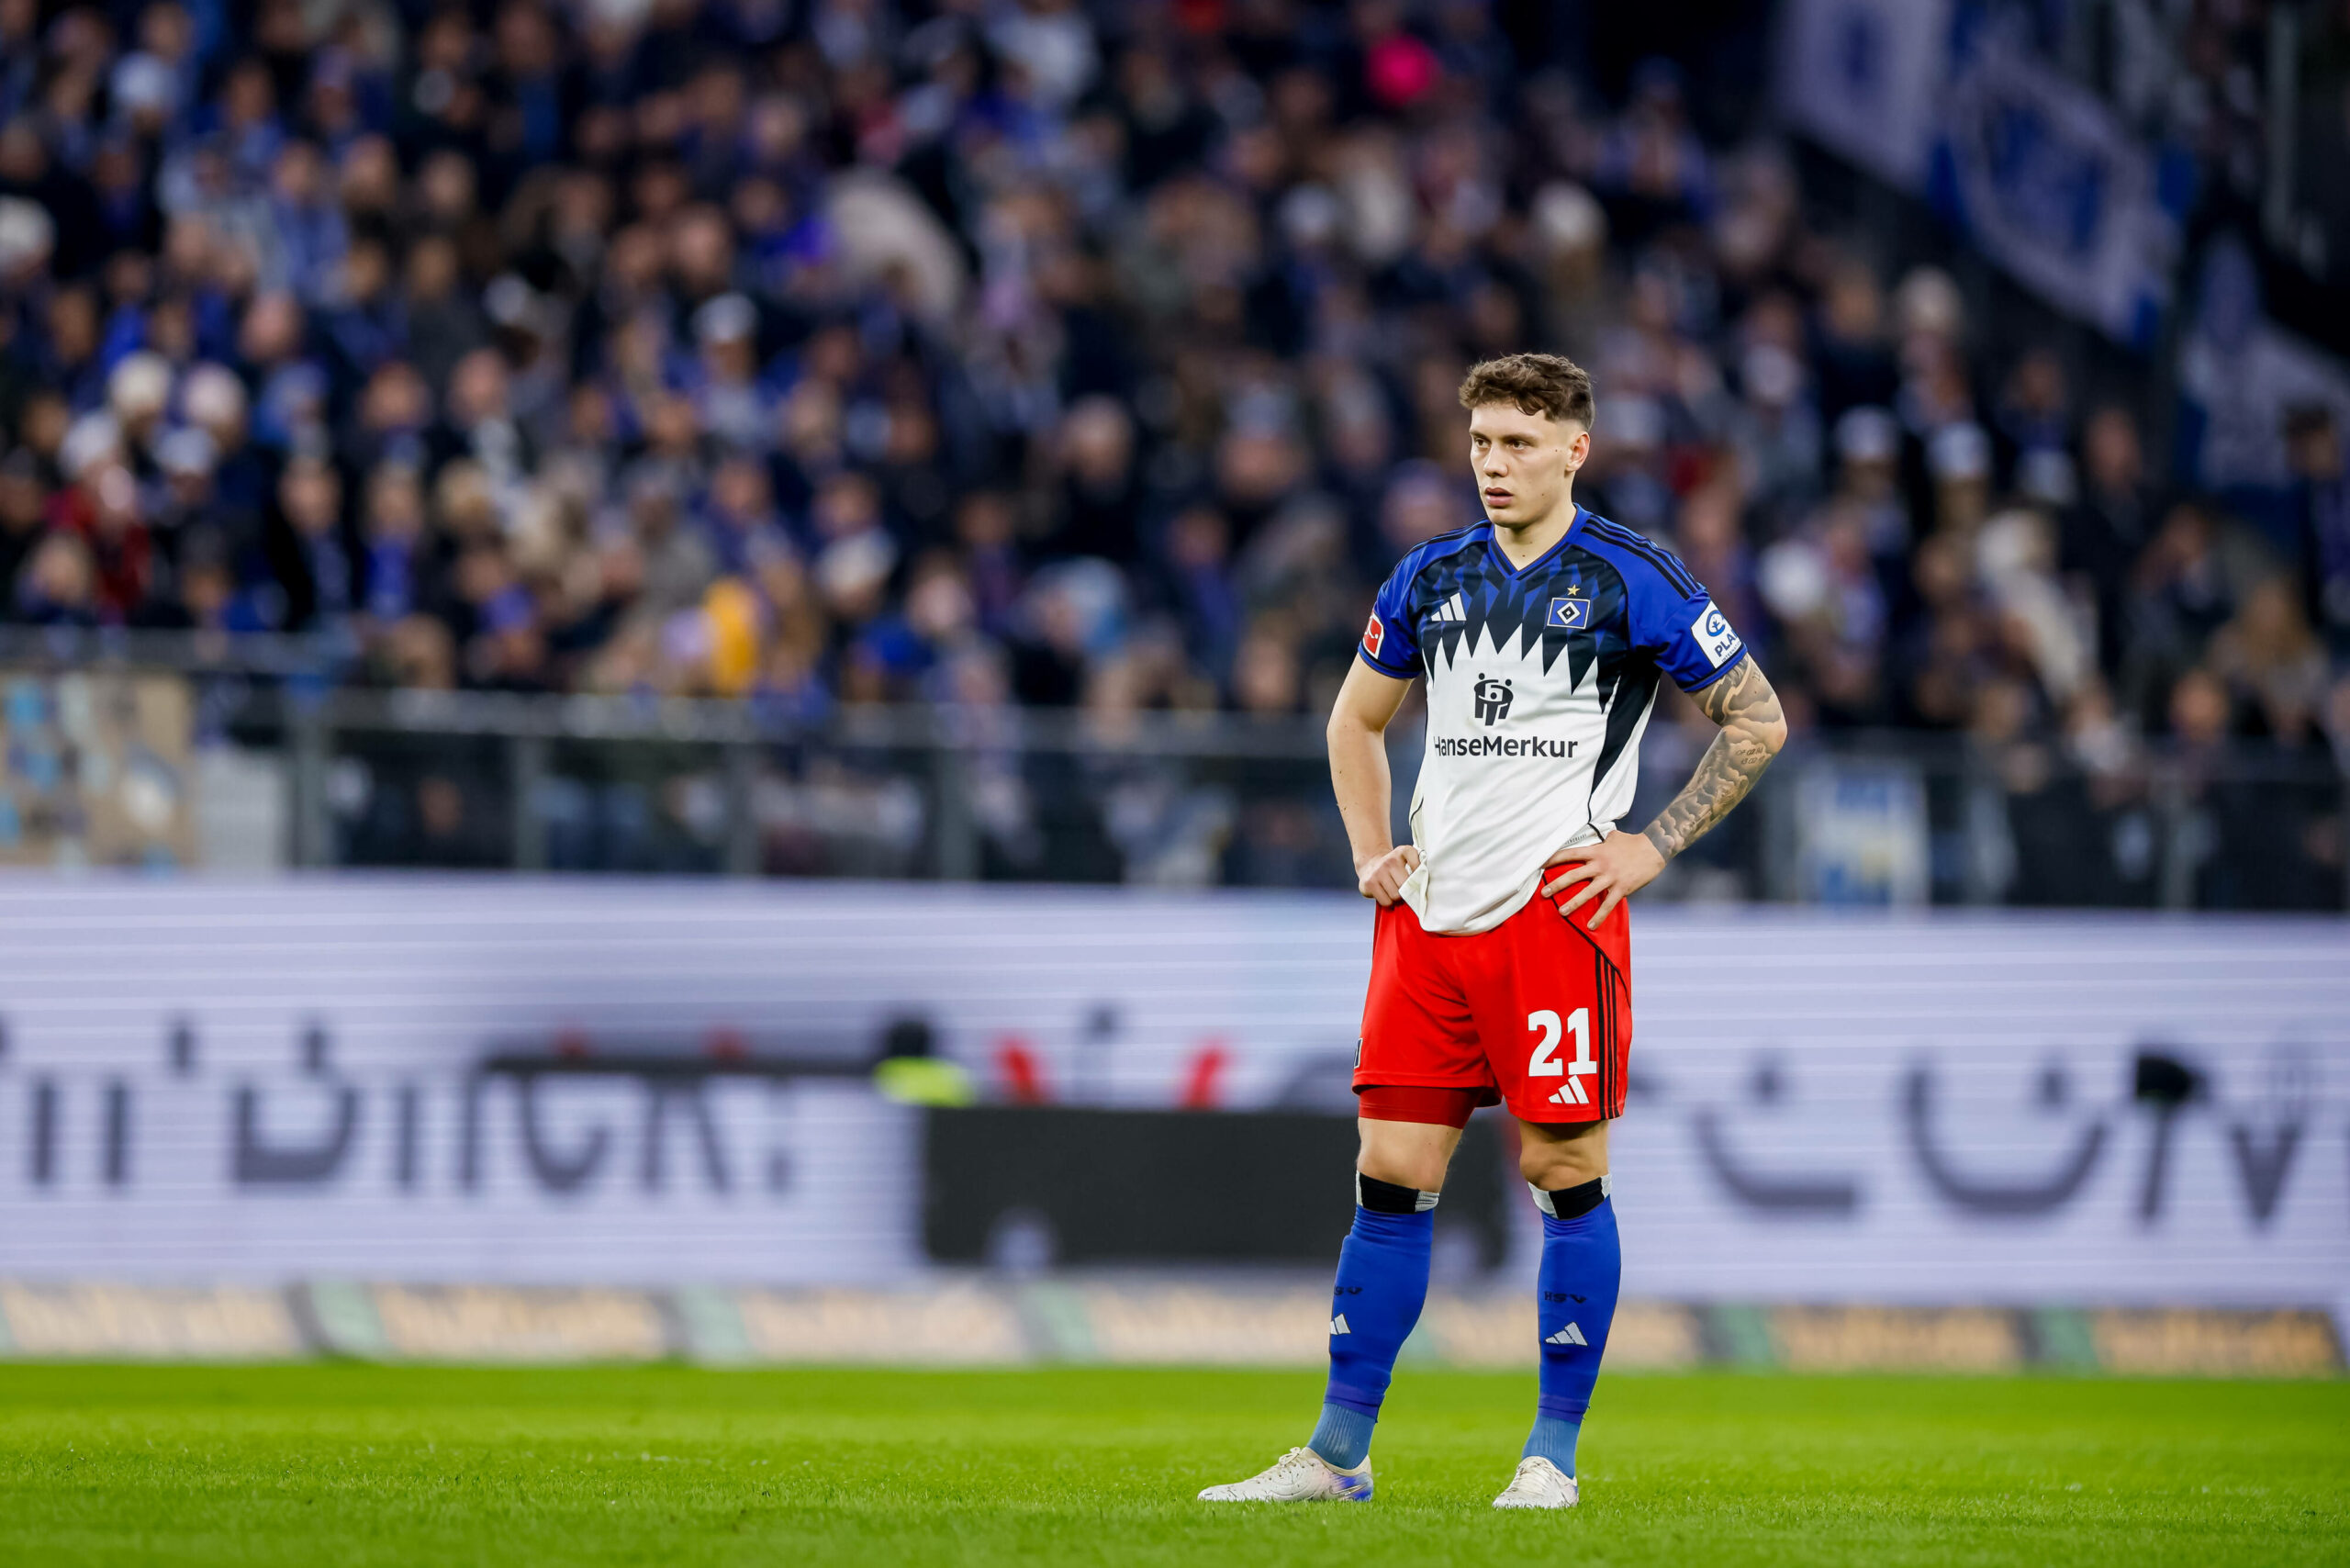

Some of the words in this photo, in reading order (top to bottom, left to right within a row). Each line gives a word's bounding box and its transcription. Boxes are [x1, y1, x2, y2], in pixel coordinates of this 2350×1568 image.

[1433, 735, 1578, 758] HanseMerkur
[1528, 1007, 1597, 1077] 21
[1333, 1284, 1363, 1295] SV
[1544, 1290, 1588, 1305] HSV
